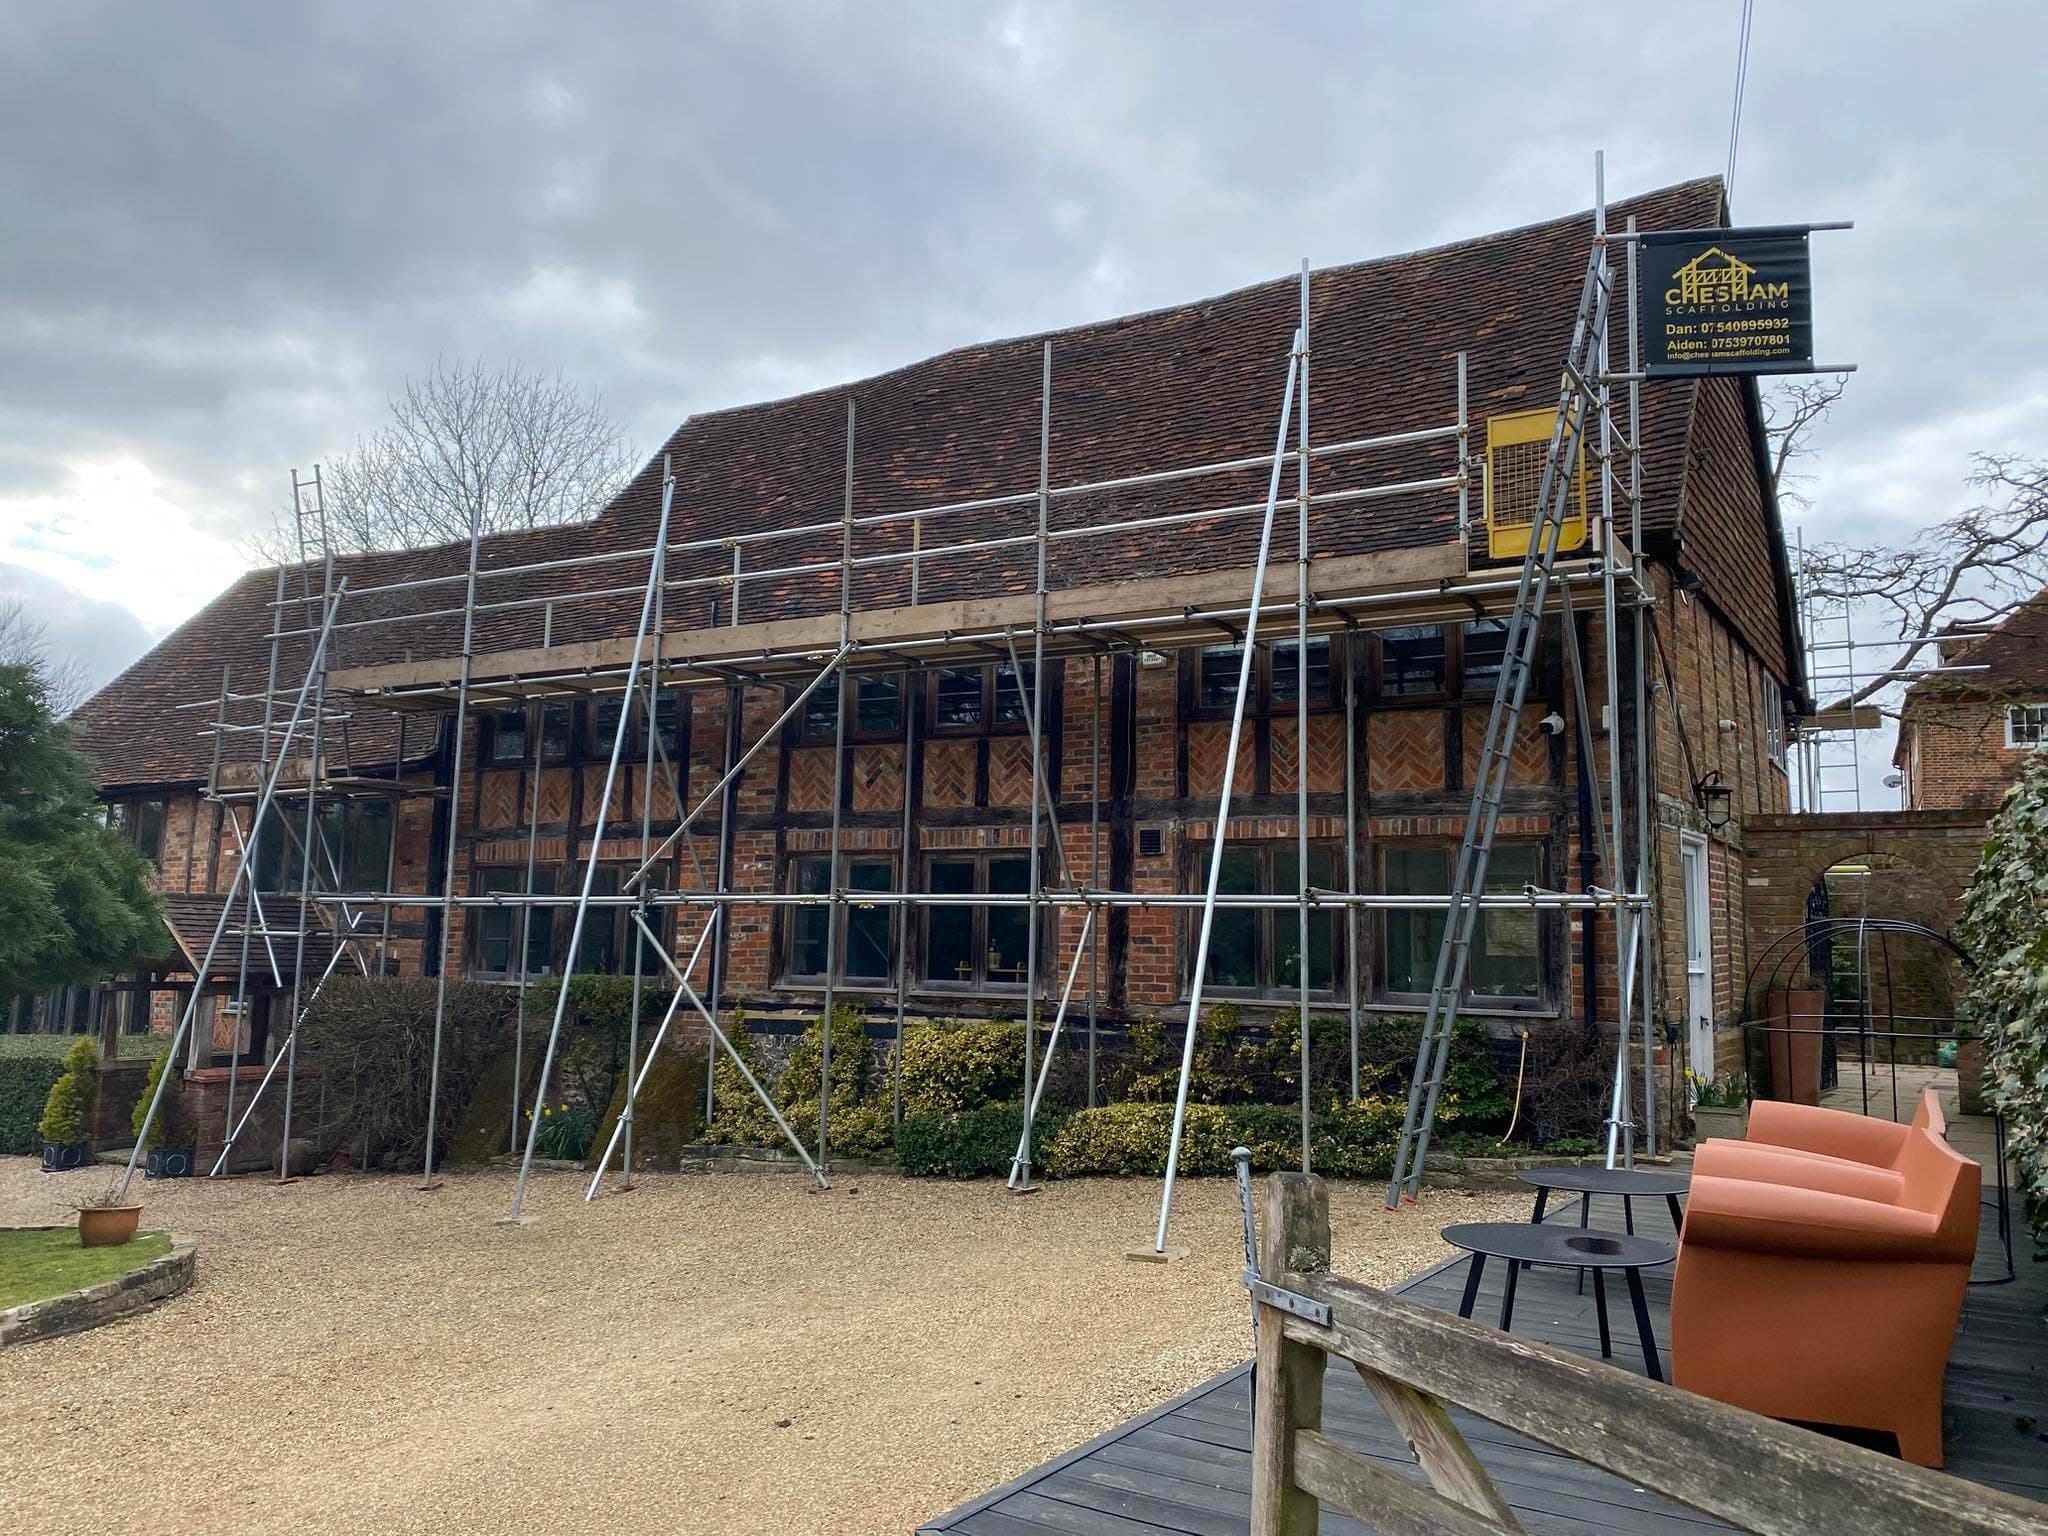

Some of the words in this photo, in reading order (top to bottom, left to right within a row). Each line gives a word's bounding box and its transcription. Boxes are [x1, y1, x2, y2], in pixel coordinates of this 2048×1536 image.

[1665, 282, 1789, 305] CHESHAM
[1665, 300, 1789, 315] SCAFFOLDING
[1666, 323, 1697, 335] Dan:
[1701, 317, 1789, 333] 07540895932
[1667, 339, 1707, 350] Aiden:
[1711, 334, 1790, 349] 07539707801
